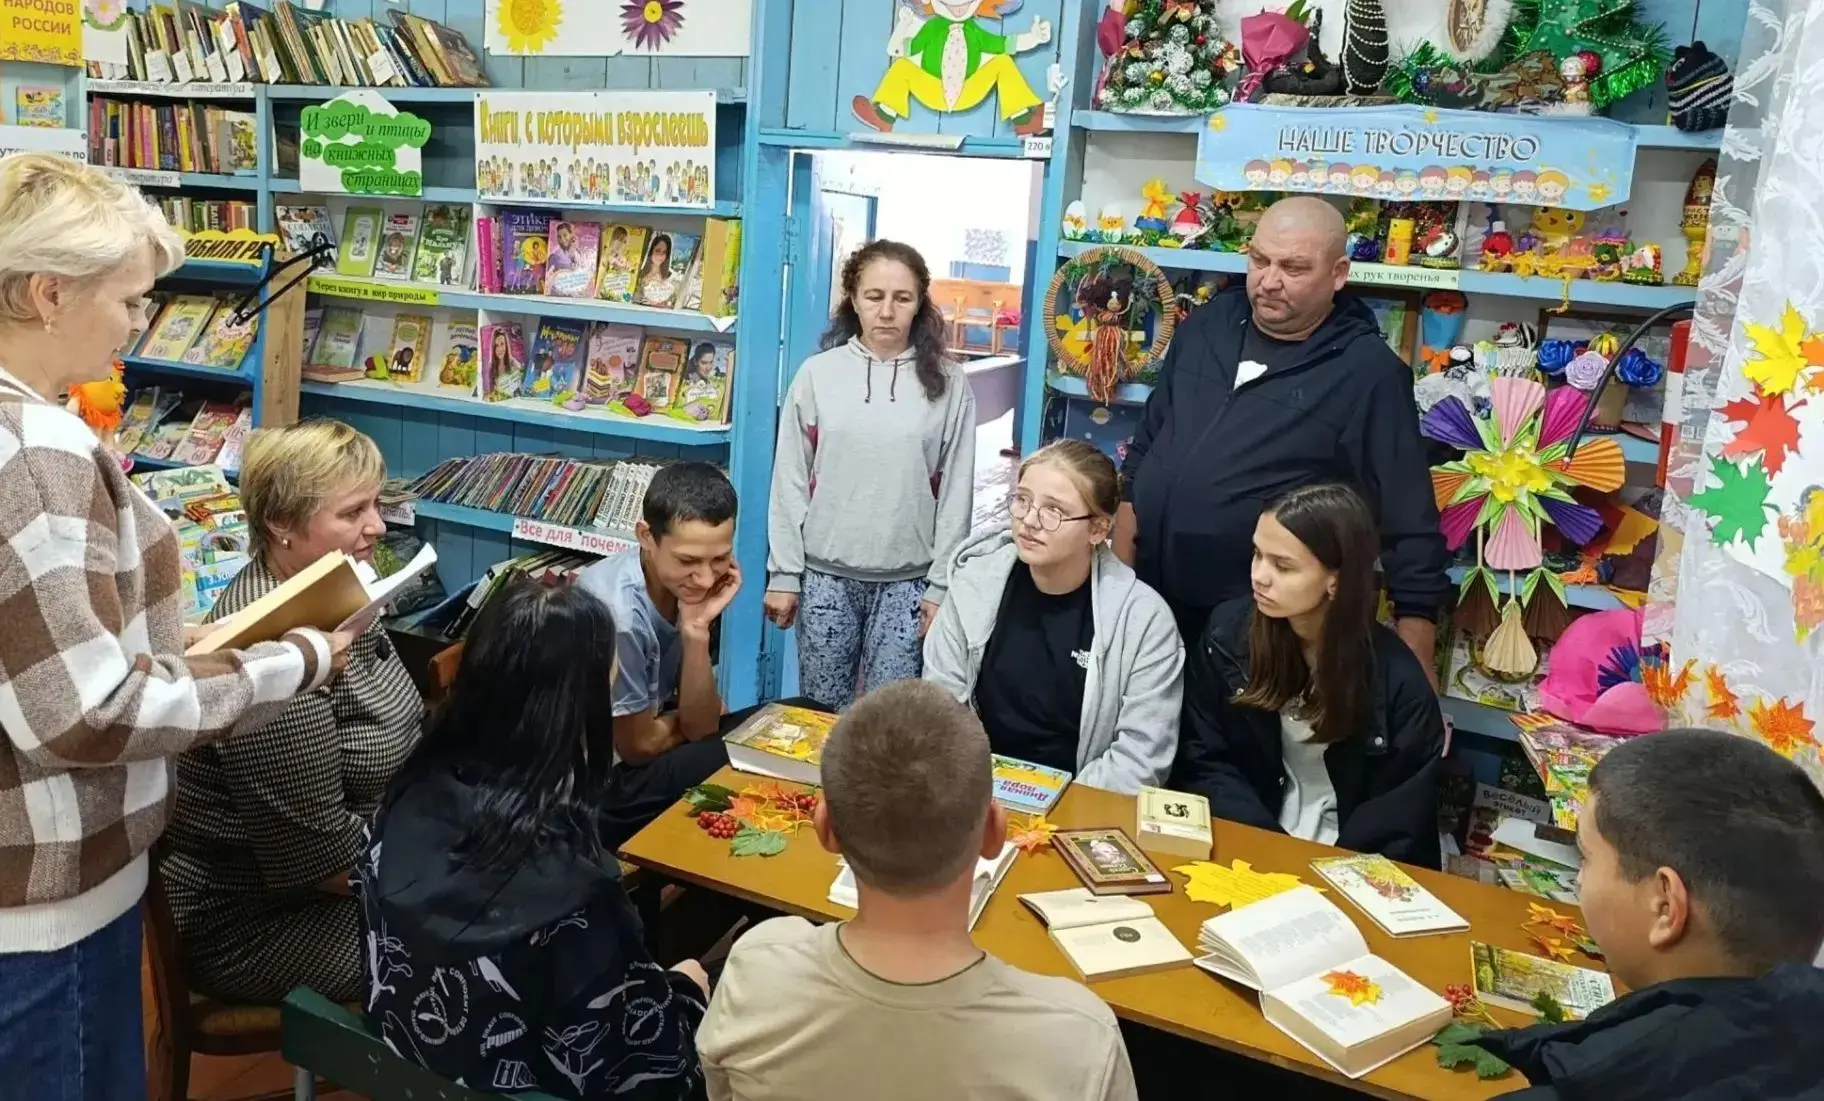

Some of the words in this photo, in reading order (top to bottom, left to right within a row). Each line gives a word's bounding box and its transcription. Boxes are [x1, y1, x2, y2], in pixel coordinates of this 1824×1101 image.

[3, 0, 75, 16] НАРОДОВ
[12, 16, 72, 36] РОССИИ
[307, 111, 321, 132] И
[323, 112, 365, 132] звери
[366, 124, 377, 136] и
[378, 124, 426, 140] птицы
[525, 111, 533, 144] с
[536, 109, 614, 155] которыми
[616, 111, 709, 156] взрослеешь
[1027, 141, 1044, 151] 220
[1278, 124, 1358, 154] НАШЕ
[1363, 129, 1540, 161] ТВОРЧЕСТВО
[304, 144, 321, 156] на
[328, 148, 393, 162] книжных
[346, 175, 419, 190] страницах
[1363, 271, 1385, 282] рук
[1387, 272, 1440, 284] творенья
[315, 281, 337, 293] Через
[388, 290, 426, 301] природы
[521, 520, 543, 537] Все
[546, 528, 573, 543] для
[580, 535, 631, 553] почем
